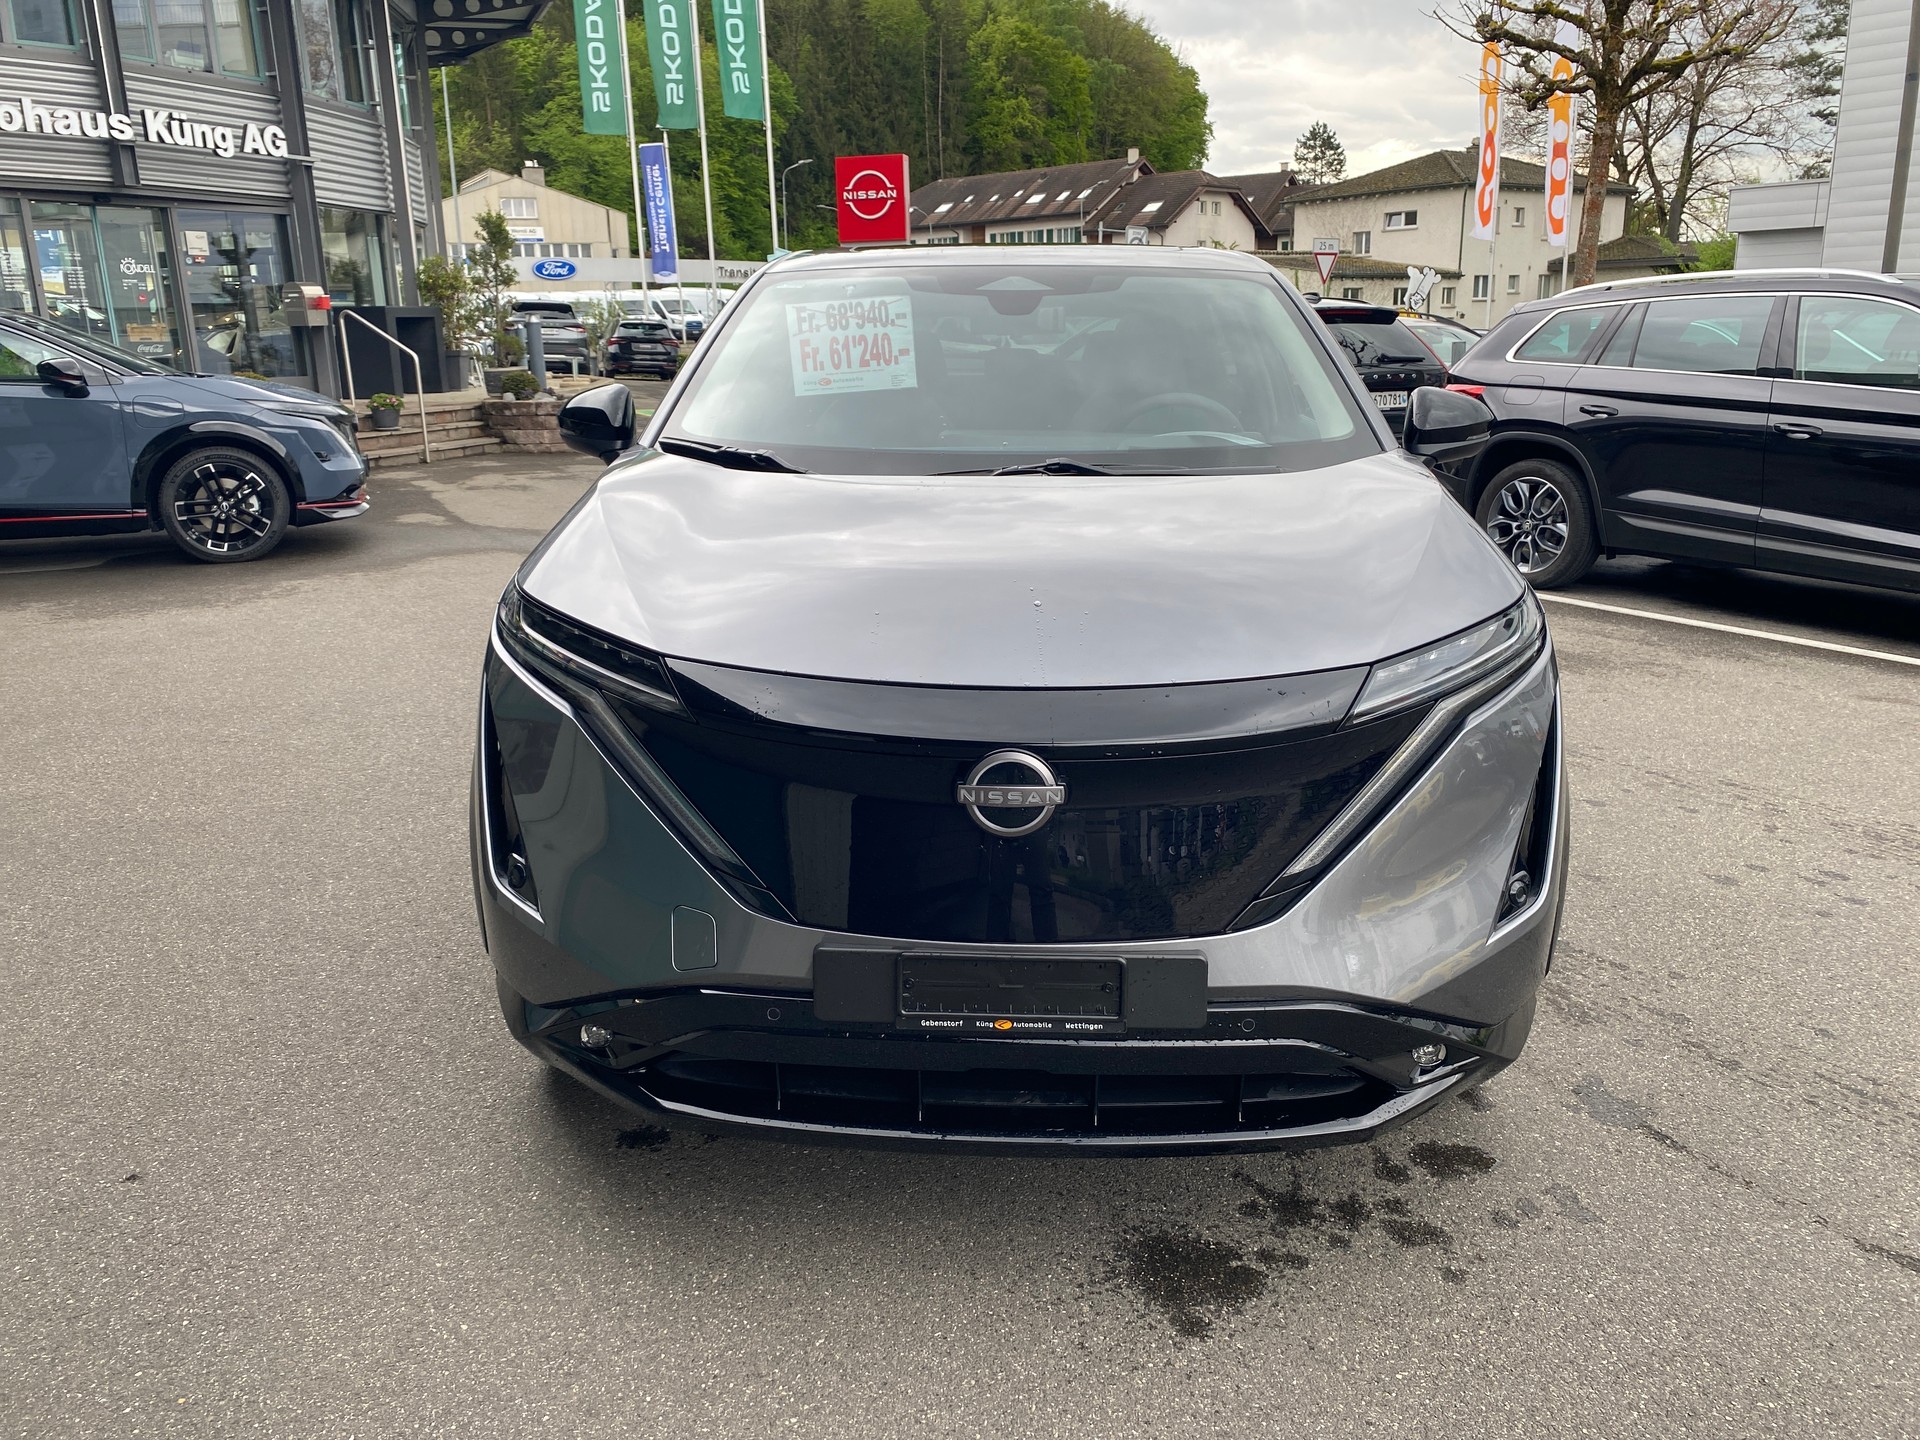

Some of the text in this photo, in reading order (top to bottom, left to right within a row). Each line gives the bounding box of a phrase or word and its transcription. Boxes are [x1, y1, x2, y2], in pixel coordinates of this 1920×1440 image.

[143, 109, 235, 158] Küng
[242, 123, 289, 158] AG
[843, 189, 897, 200] NISSAN
[1319, 241, 1327, 251] 25
[541, 262, 570, 276] Ford
[795, 305, 821, 333] Fr.
[800, 333, 910, 373] Fr. 61'240.-
[960, 788, 1062, 804] NISSAN
[921, 1019, 964, 1027] Gebenstorf
[976, 1020, 994, 1028] Küng
[1065, 1022, 1103, 1030] Wettingen
